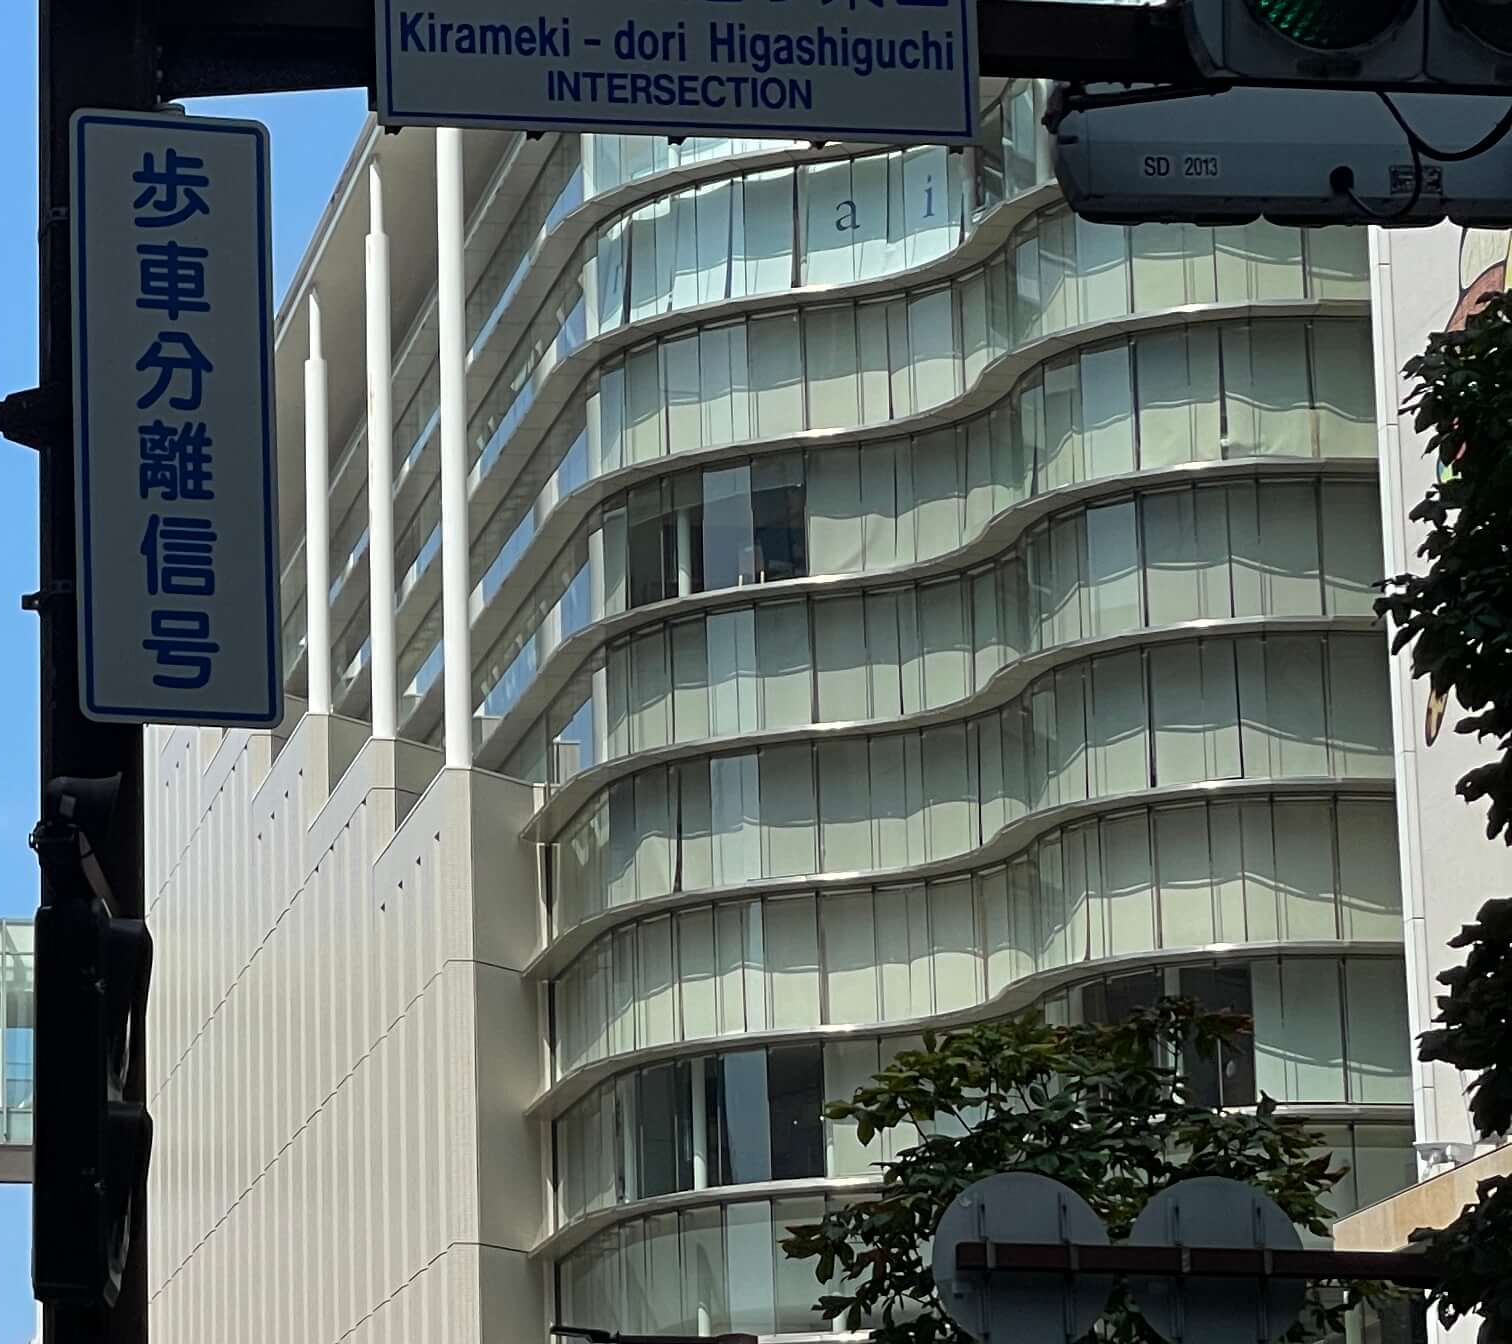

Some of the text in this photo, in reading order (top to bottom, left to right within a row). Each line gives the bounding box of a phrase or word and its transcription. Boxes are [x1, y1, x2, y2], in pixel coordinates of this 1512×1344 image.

[399, 12, 571, 58] Kirameki
[615, 21, 687, 63] dori
[710, 22, 955, 77] Higashiguchi
[546, 70, 814, 111] INTERSECTION
[1144, 156, 1219, 178] SD 2013
[131, 147, 221, 690] 歩車分離信号
